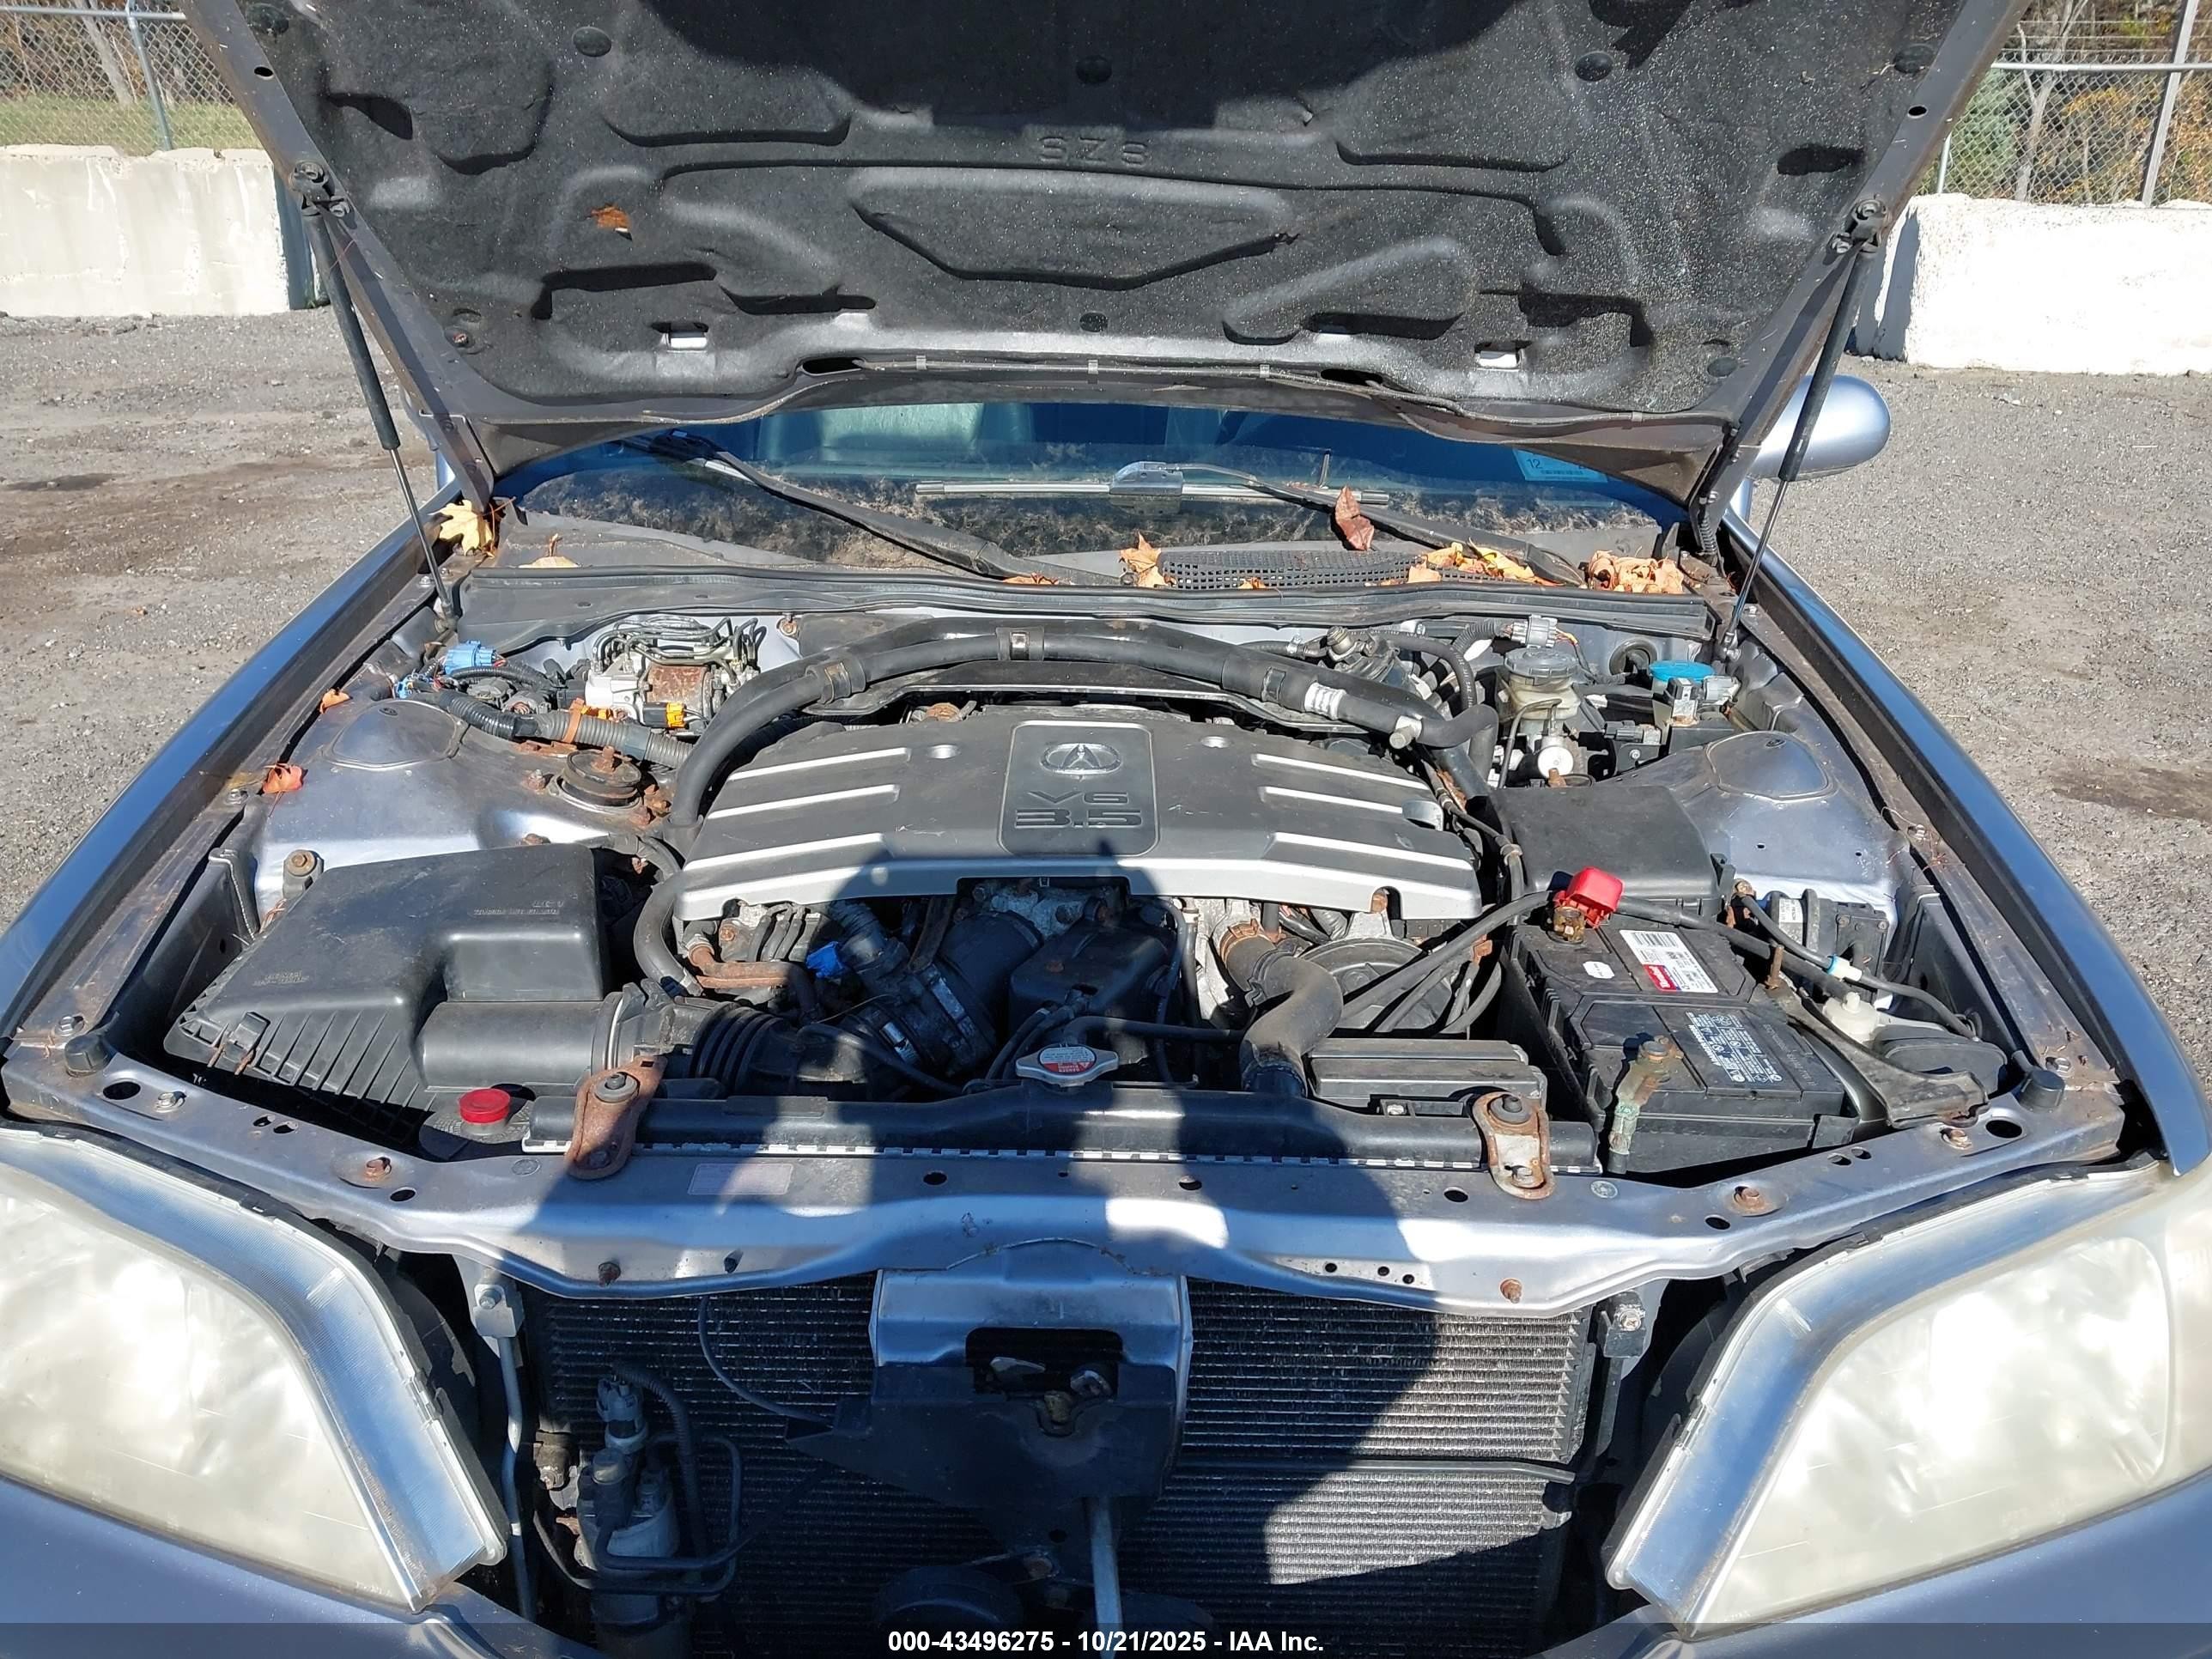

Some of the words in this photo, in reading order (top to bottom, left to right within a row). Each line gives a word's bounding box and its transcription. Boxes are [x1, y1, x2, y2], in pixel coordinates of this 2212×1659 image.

[1526, 459, 1543, 469] 12
[1026, 790, 1128, 805] V6
[1014, 808, 1143, 829] 3.5
